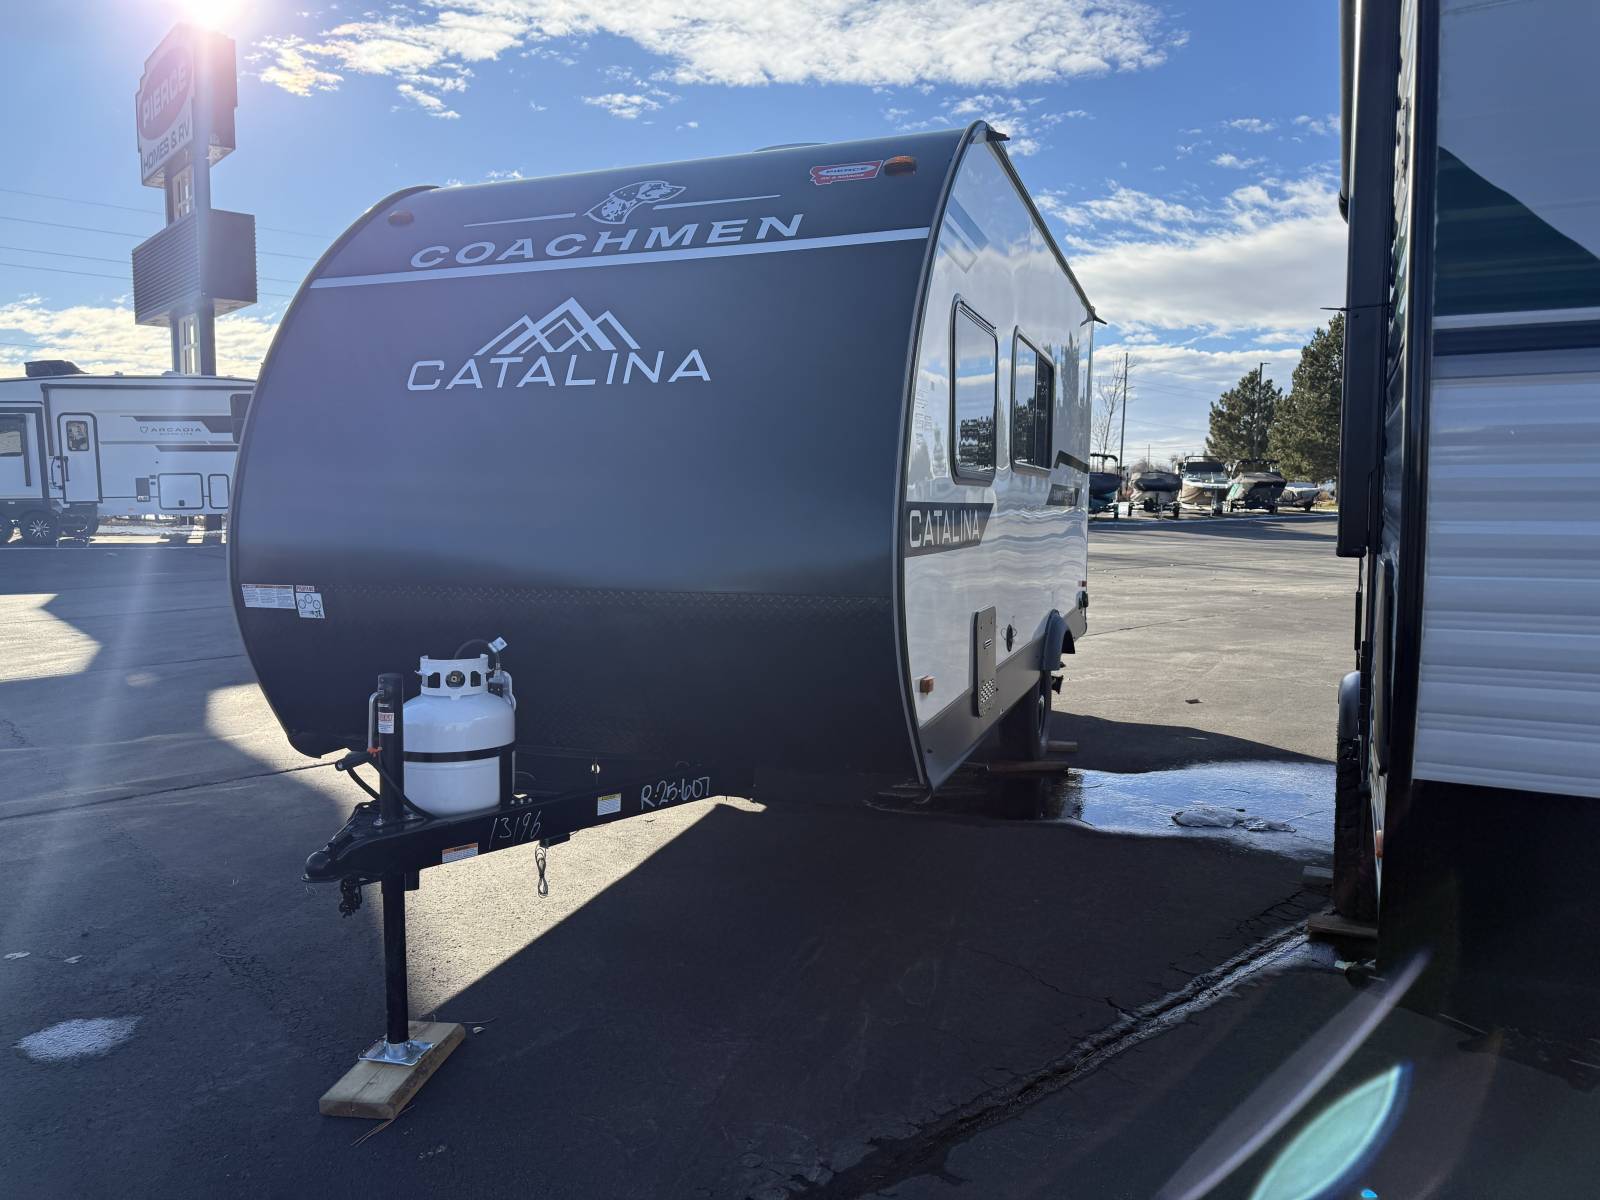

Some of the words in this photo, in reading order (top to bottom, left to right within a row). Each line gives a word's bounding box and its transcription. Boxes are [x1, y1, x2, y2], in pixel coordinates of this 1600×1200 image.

[142, 65, 187, 129] PIERCE
[142, 136, 170, 174] HOMES
[170, 129, 178, 150] &
[178, 119, 190, 143] RV
[410, 213, 804, 268] COACHMEN
[407, 348, 711, 391] CATALINA
[909, 509, 980, 548] CATALINA
[488, 809, 542, 849] 13196
